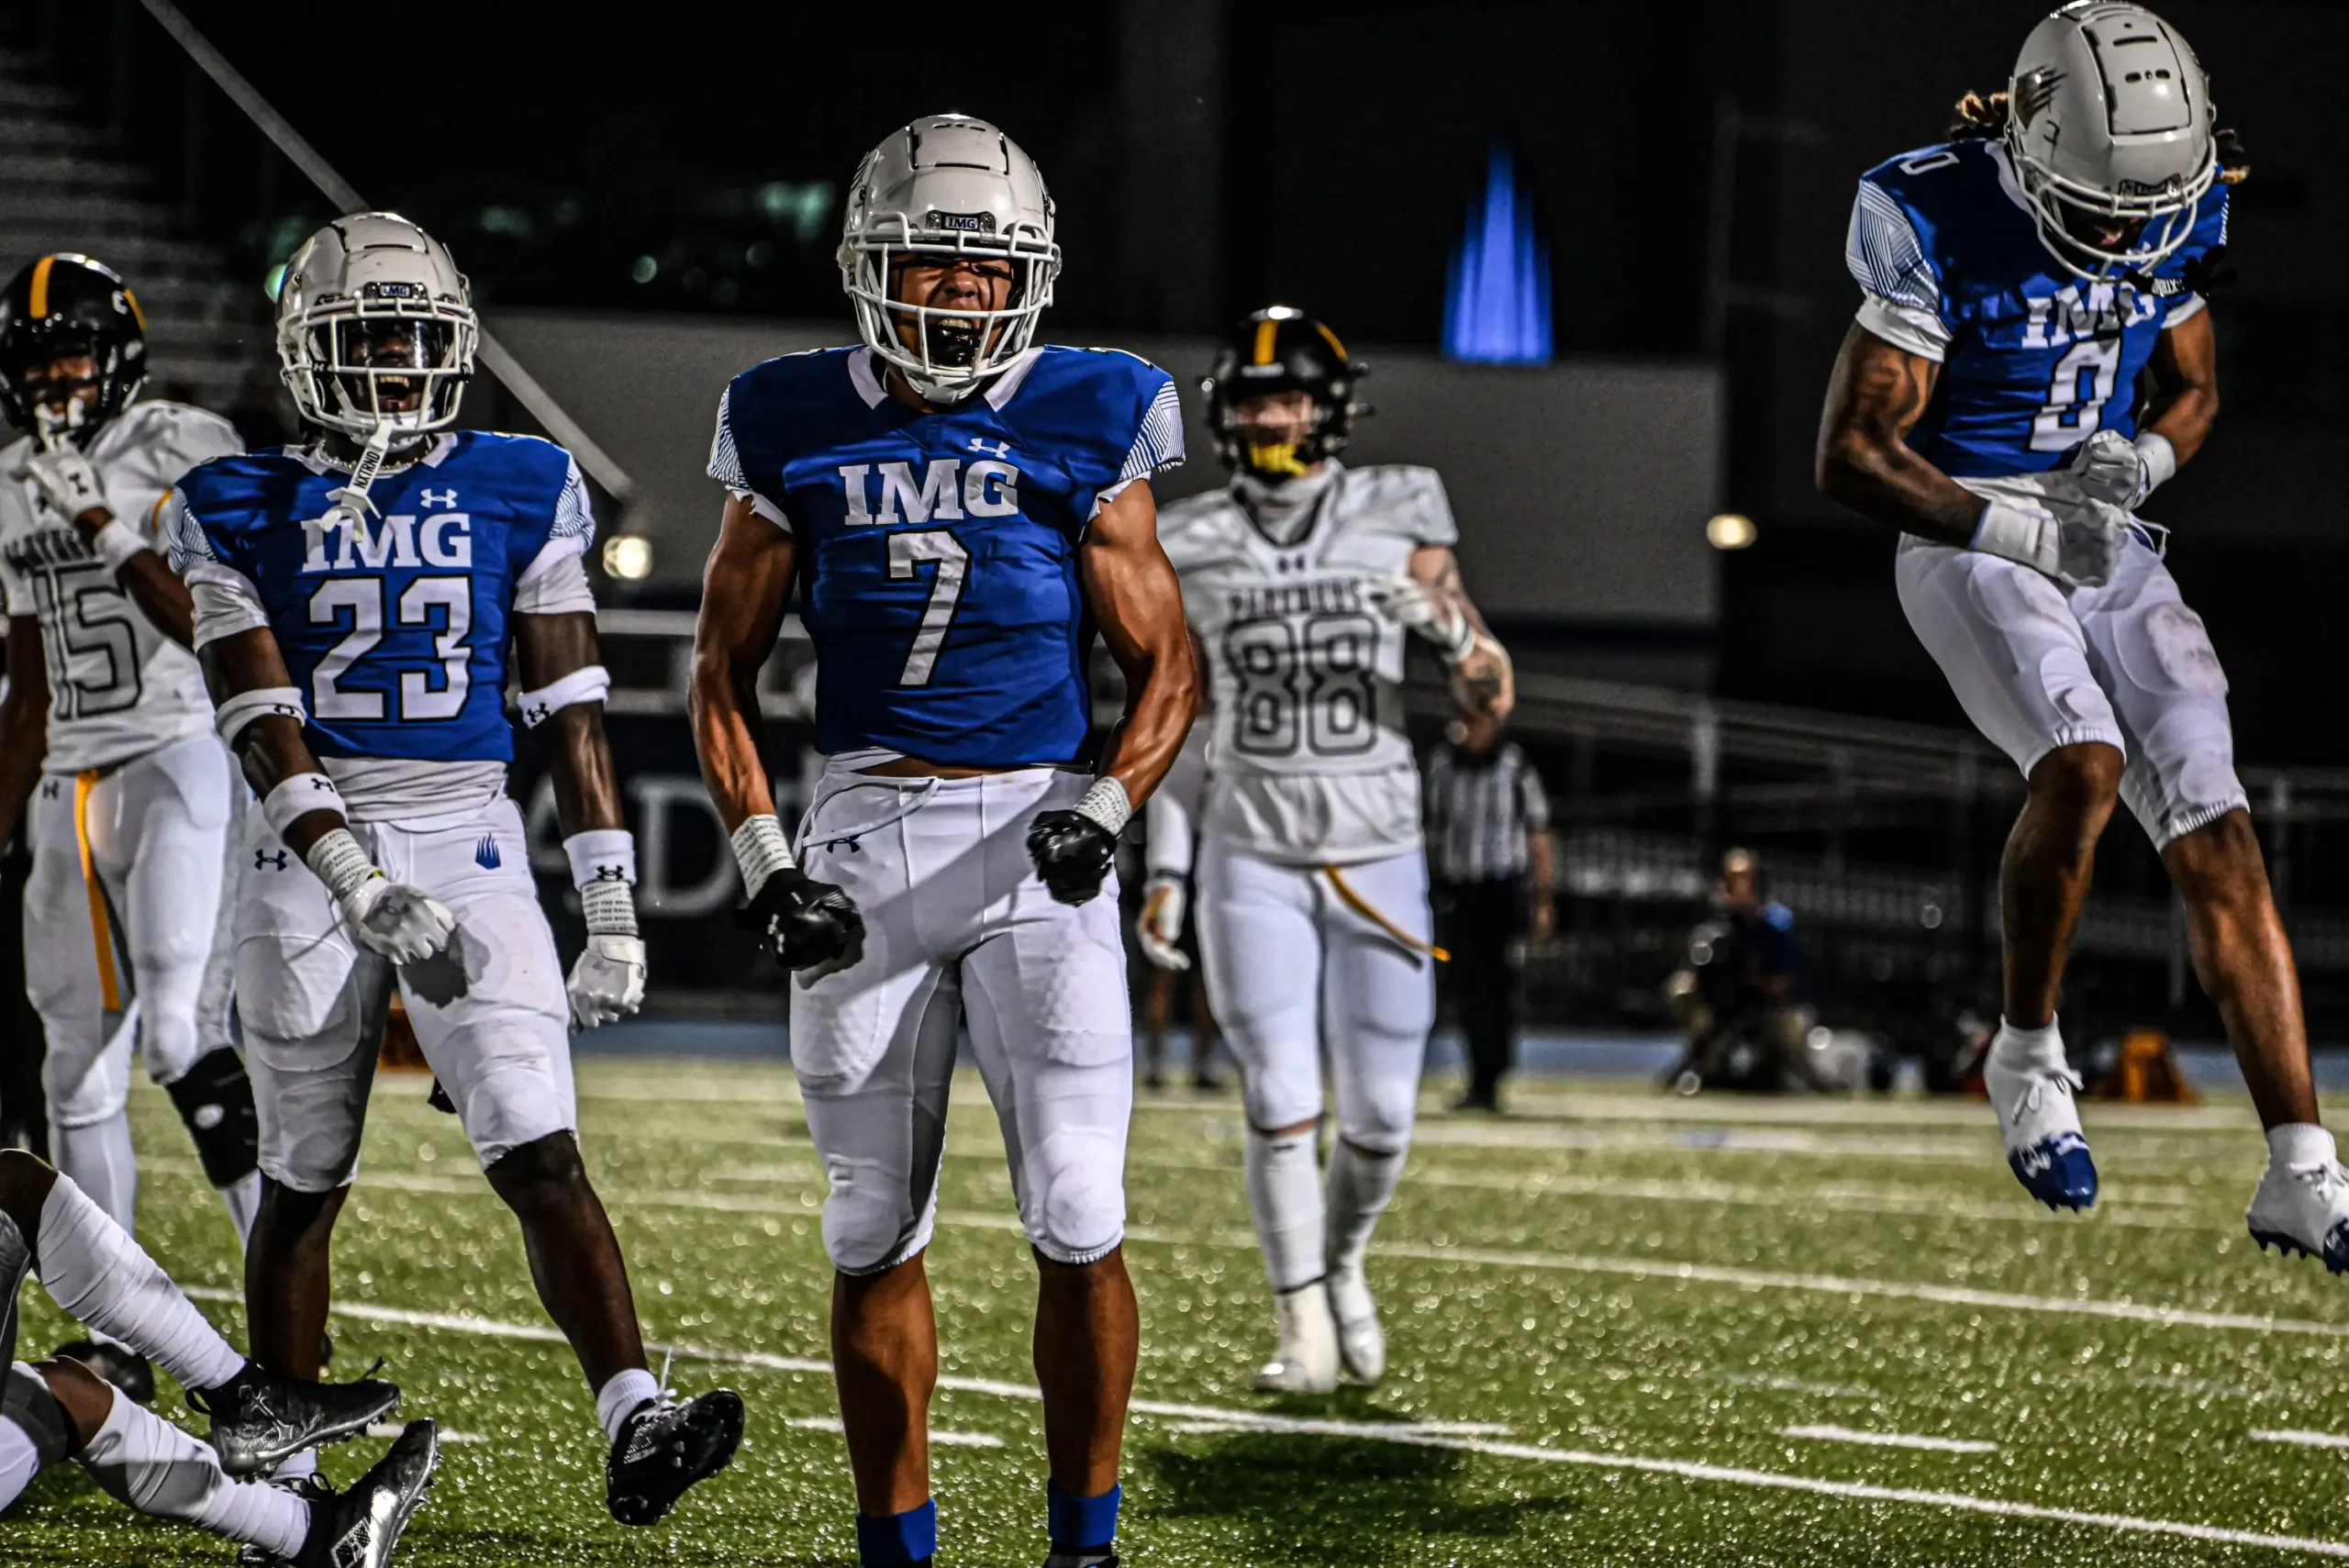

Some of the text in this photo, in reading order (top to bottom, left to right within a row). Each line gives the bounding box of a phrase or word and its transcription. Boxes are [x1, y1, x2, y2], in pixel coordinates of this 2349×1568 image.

[948, 217, 976, 229] IMG
[2021, 279, 2156, 349] IMG
[351, 450, 381, 490] NXTRND
[839, 459, 1019, 526] IMG
[300, 512, 473, 573] IMG
[31, 562, 141, 721] 15
[886, 528, 971, 686] 7
[307, 574, 473, 723] 23
[1222, 616, 1381, 758] 88
